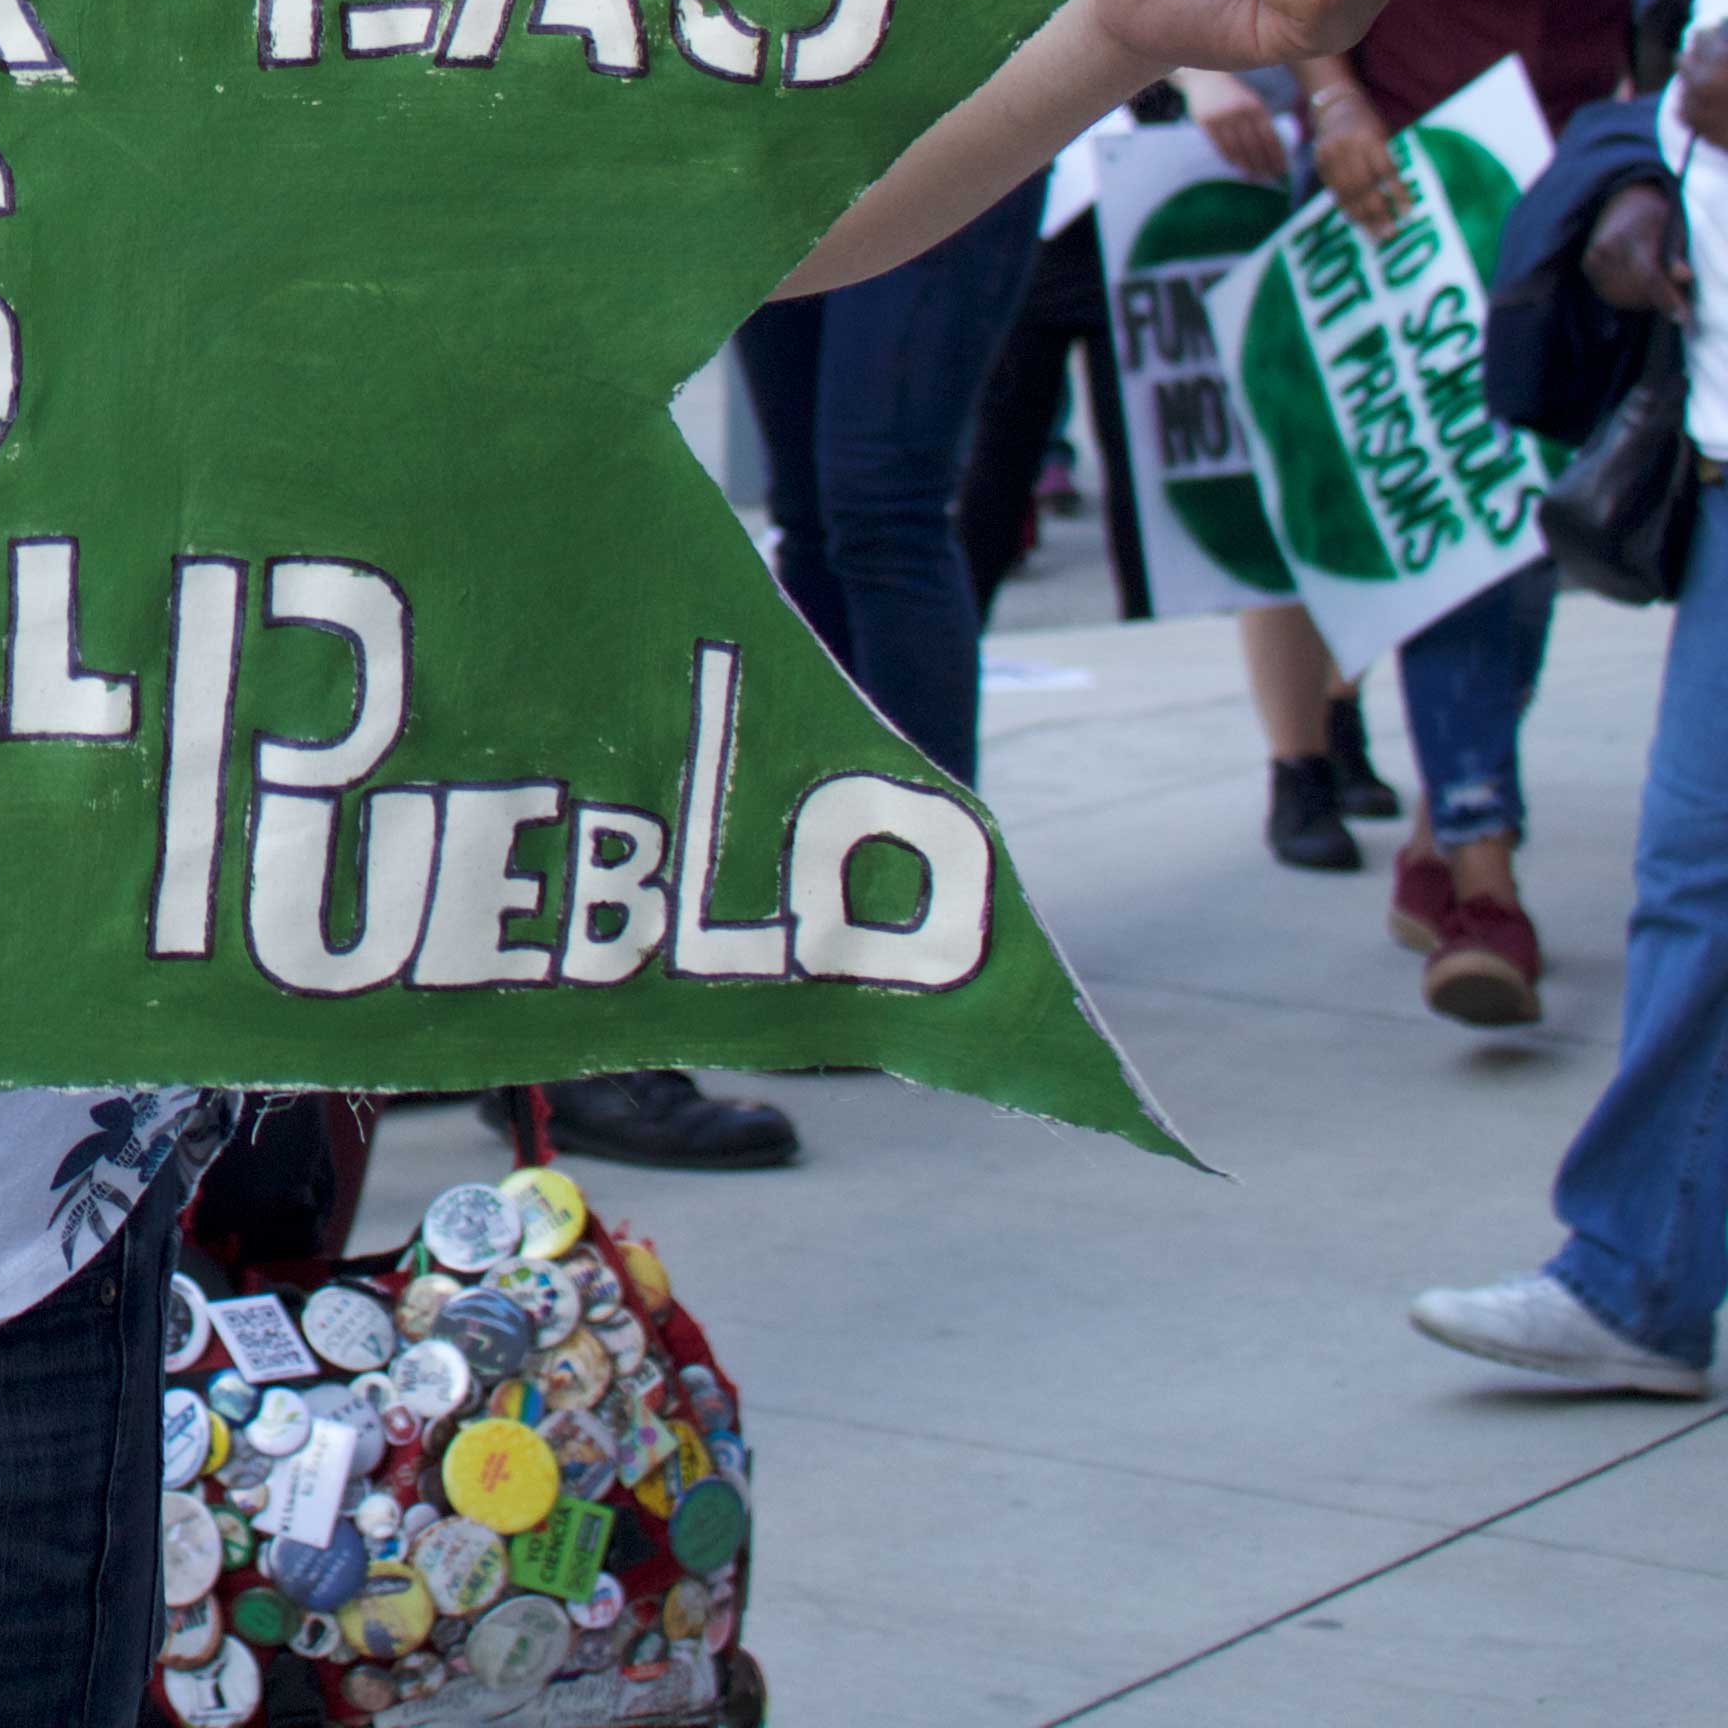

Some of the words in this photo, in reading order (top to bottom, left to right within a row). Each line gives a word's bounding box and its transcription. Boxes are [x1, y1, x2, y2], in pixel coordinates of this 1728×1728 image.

[1153, 374, 1234, 468] NO
[1292, 213, 1372, 328] NOT
[1337, 325, 1463, 575] PRISONS
[147, 555, 994, 997] PUEBLO
